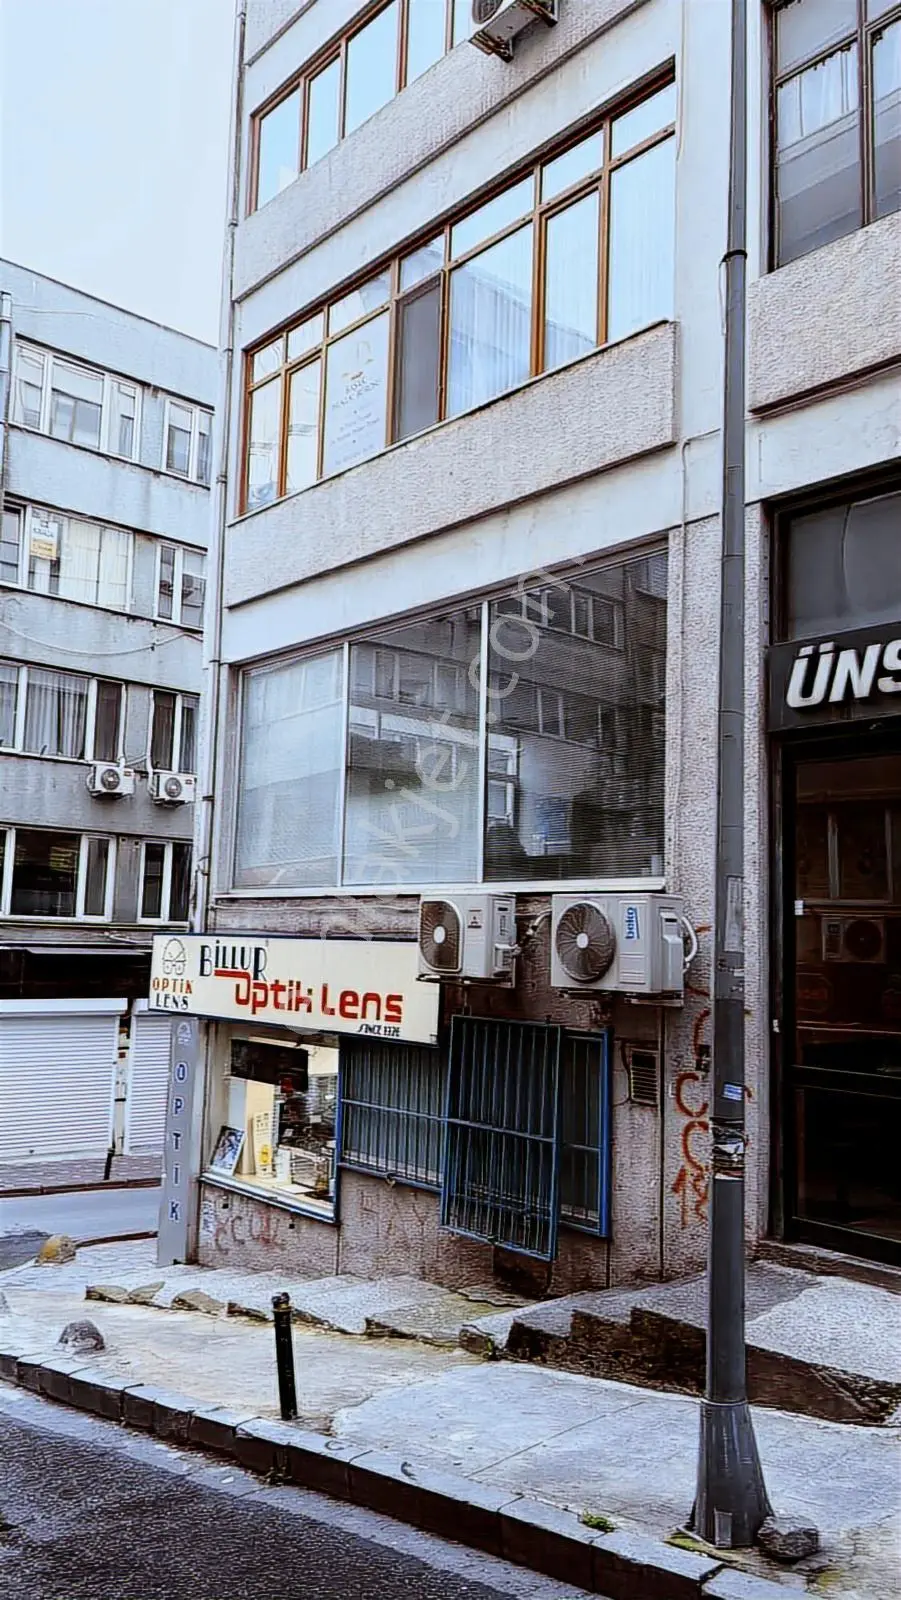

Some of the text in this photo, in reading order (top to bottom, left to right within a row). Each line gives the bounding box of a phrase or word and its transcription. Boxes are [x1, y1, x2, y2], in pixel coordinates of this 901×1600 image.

[625, 906, 640, 939] beko
[155, 993, 189, 1010] LENS
[322, 983, 404, 1023] Lens
